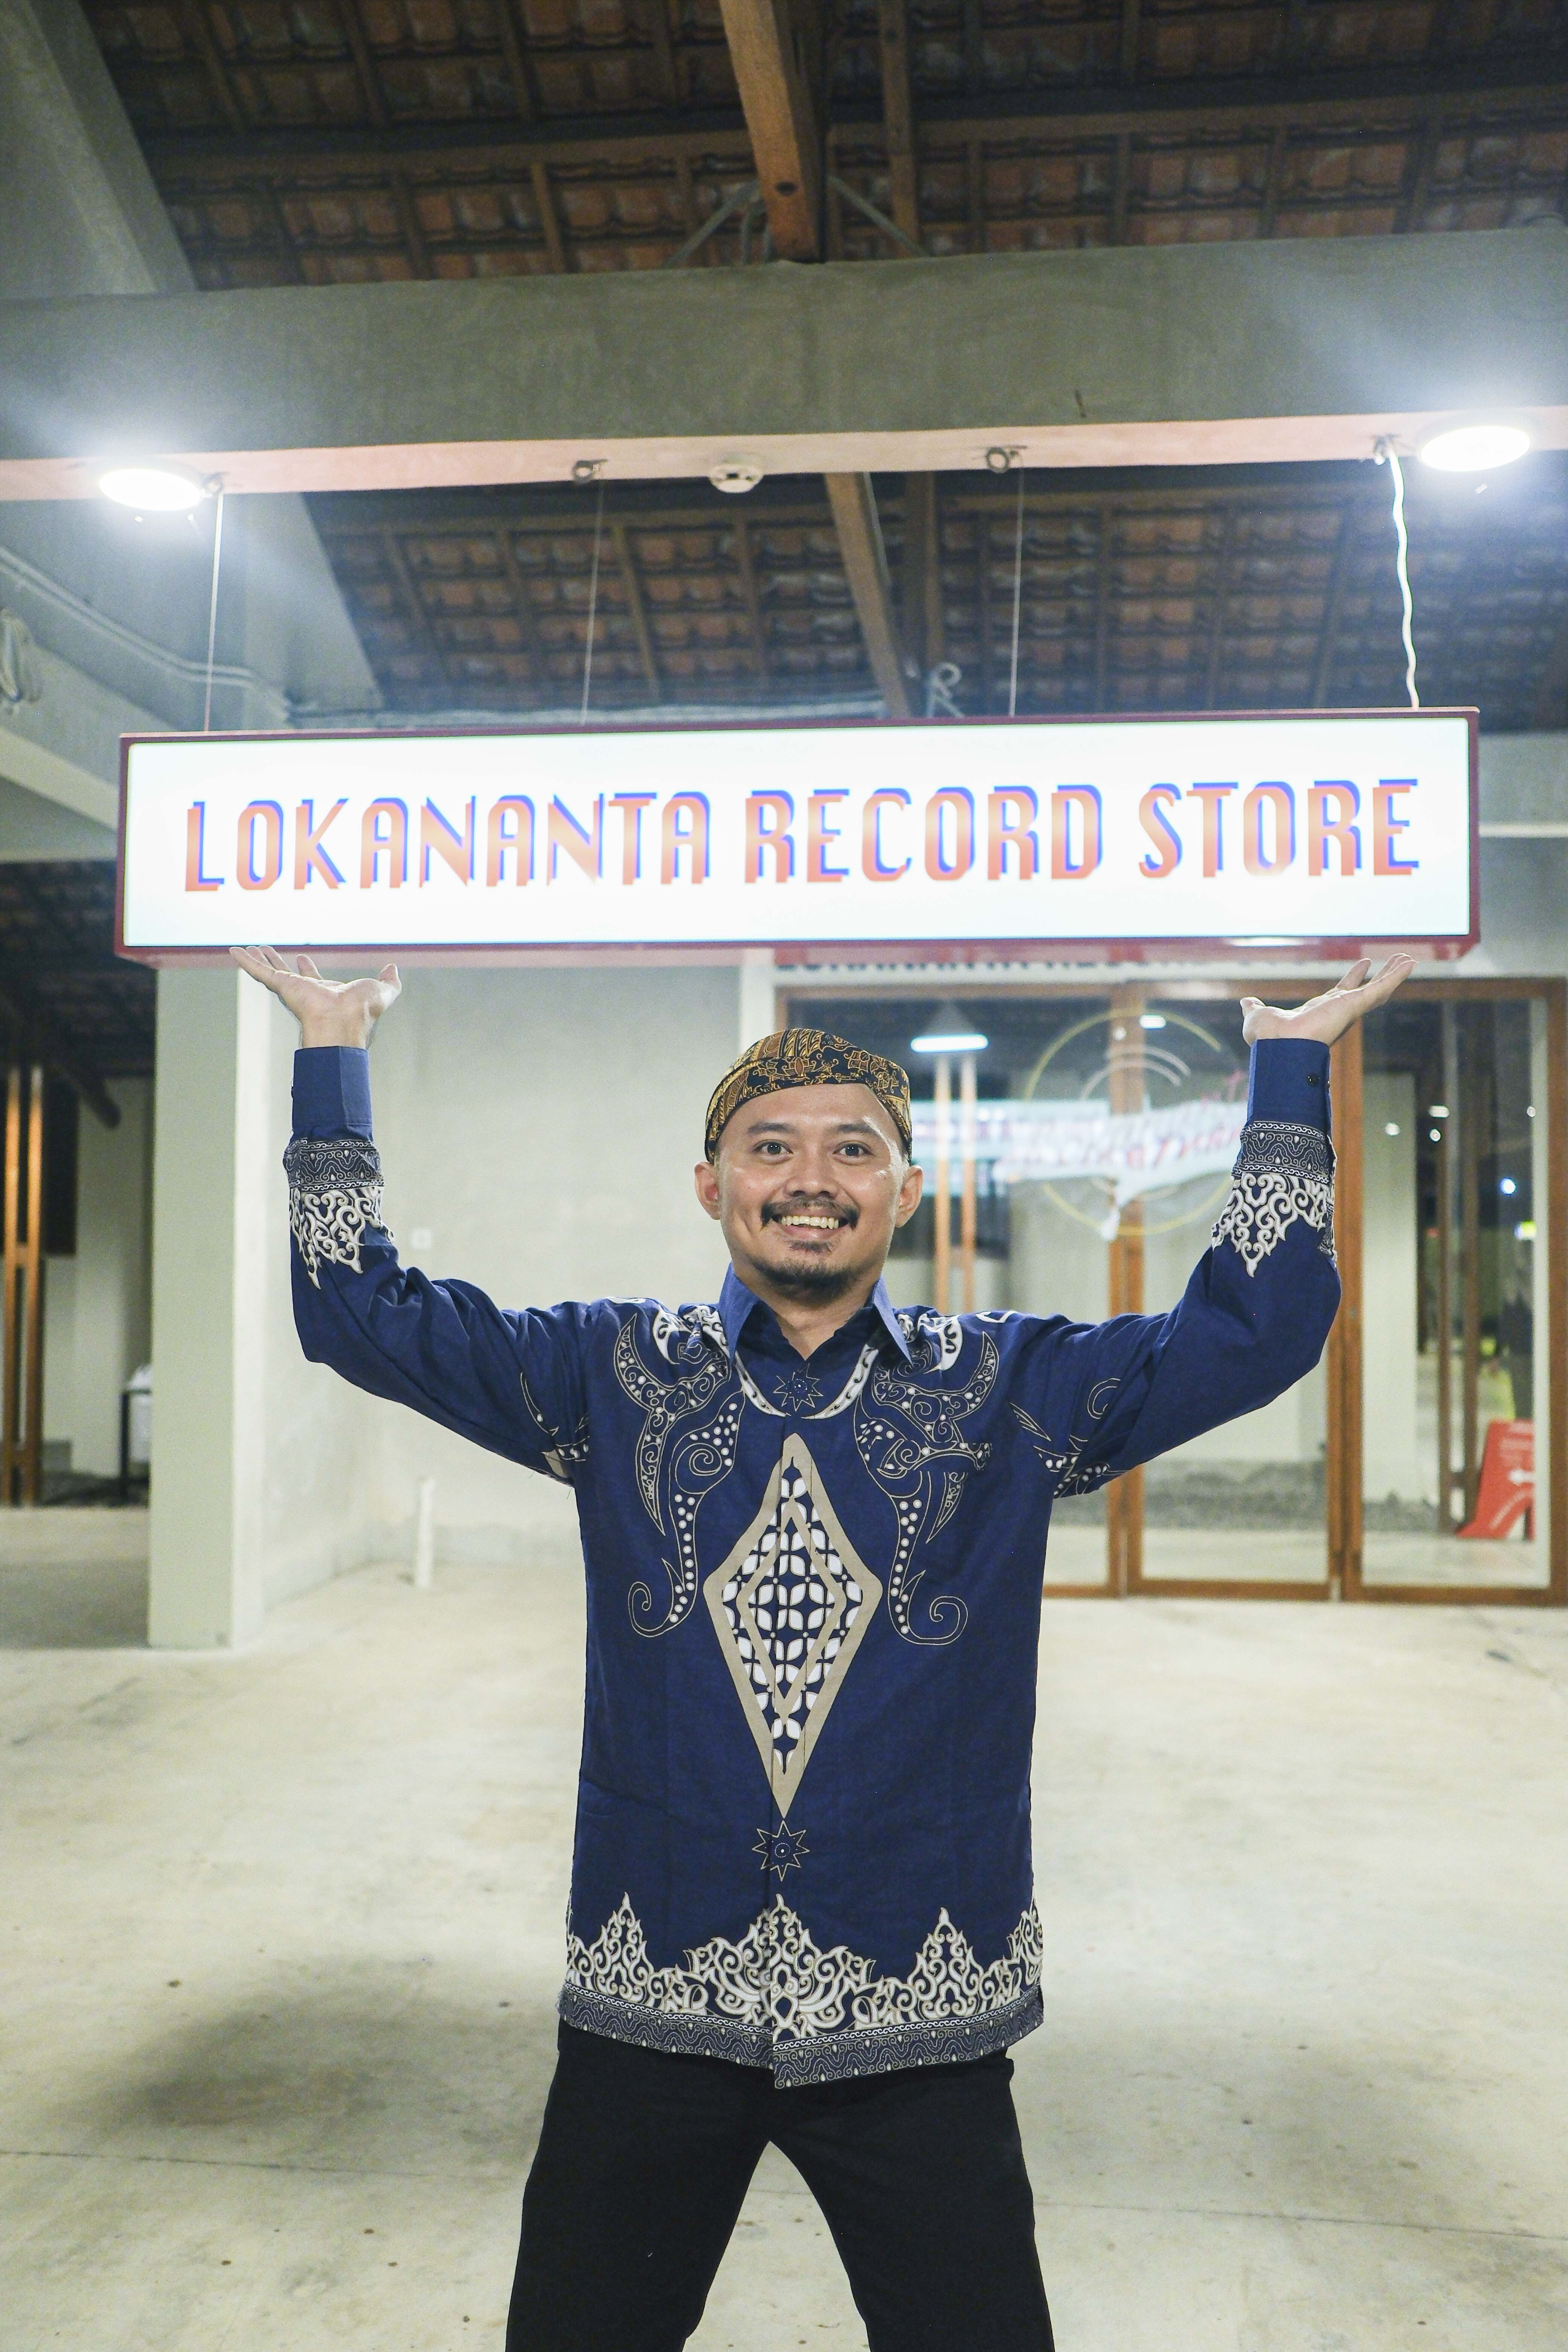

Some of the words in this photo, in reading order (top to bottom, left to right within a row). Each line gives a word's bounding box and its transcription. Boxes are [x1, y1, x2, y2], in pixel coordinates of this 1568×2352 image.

[185, 791, 711, 892] LOKANANTA
[744, 784, 1103, 884] RECORD
[1138, 778, 1419, 878] STORE
